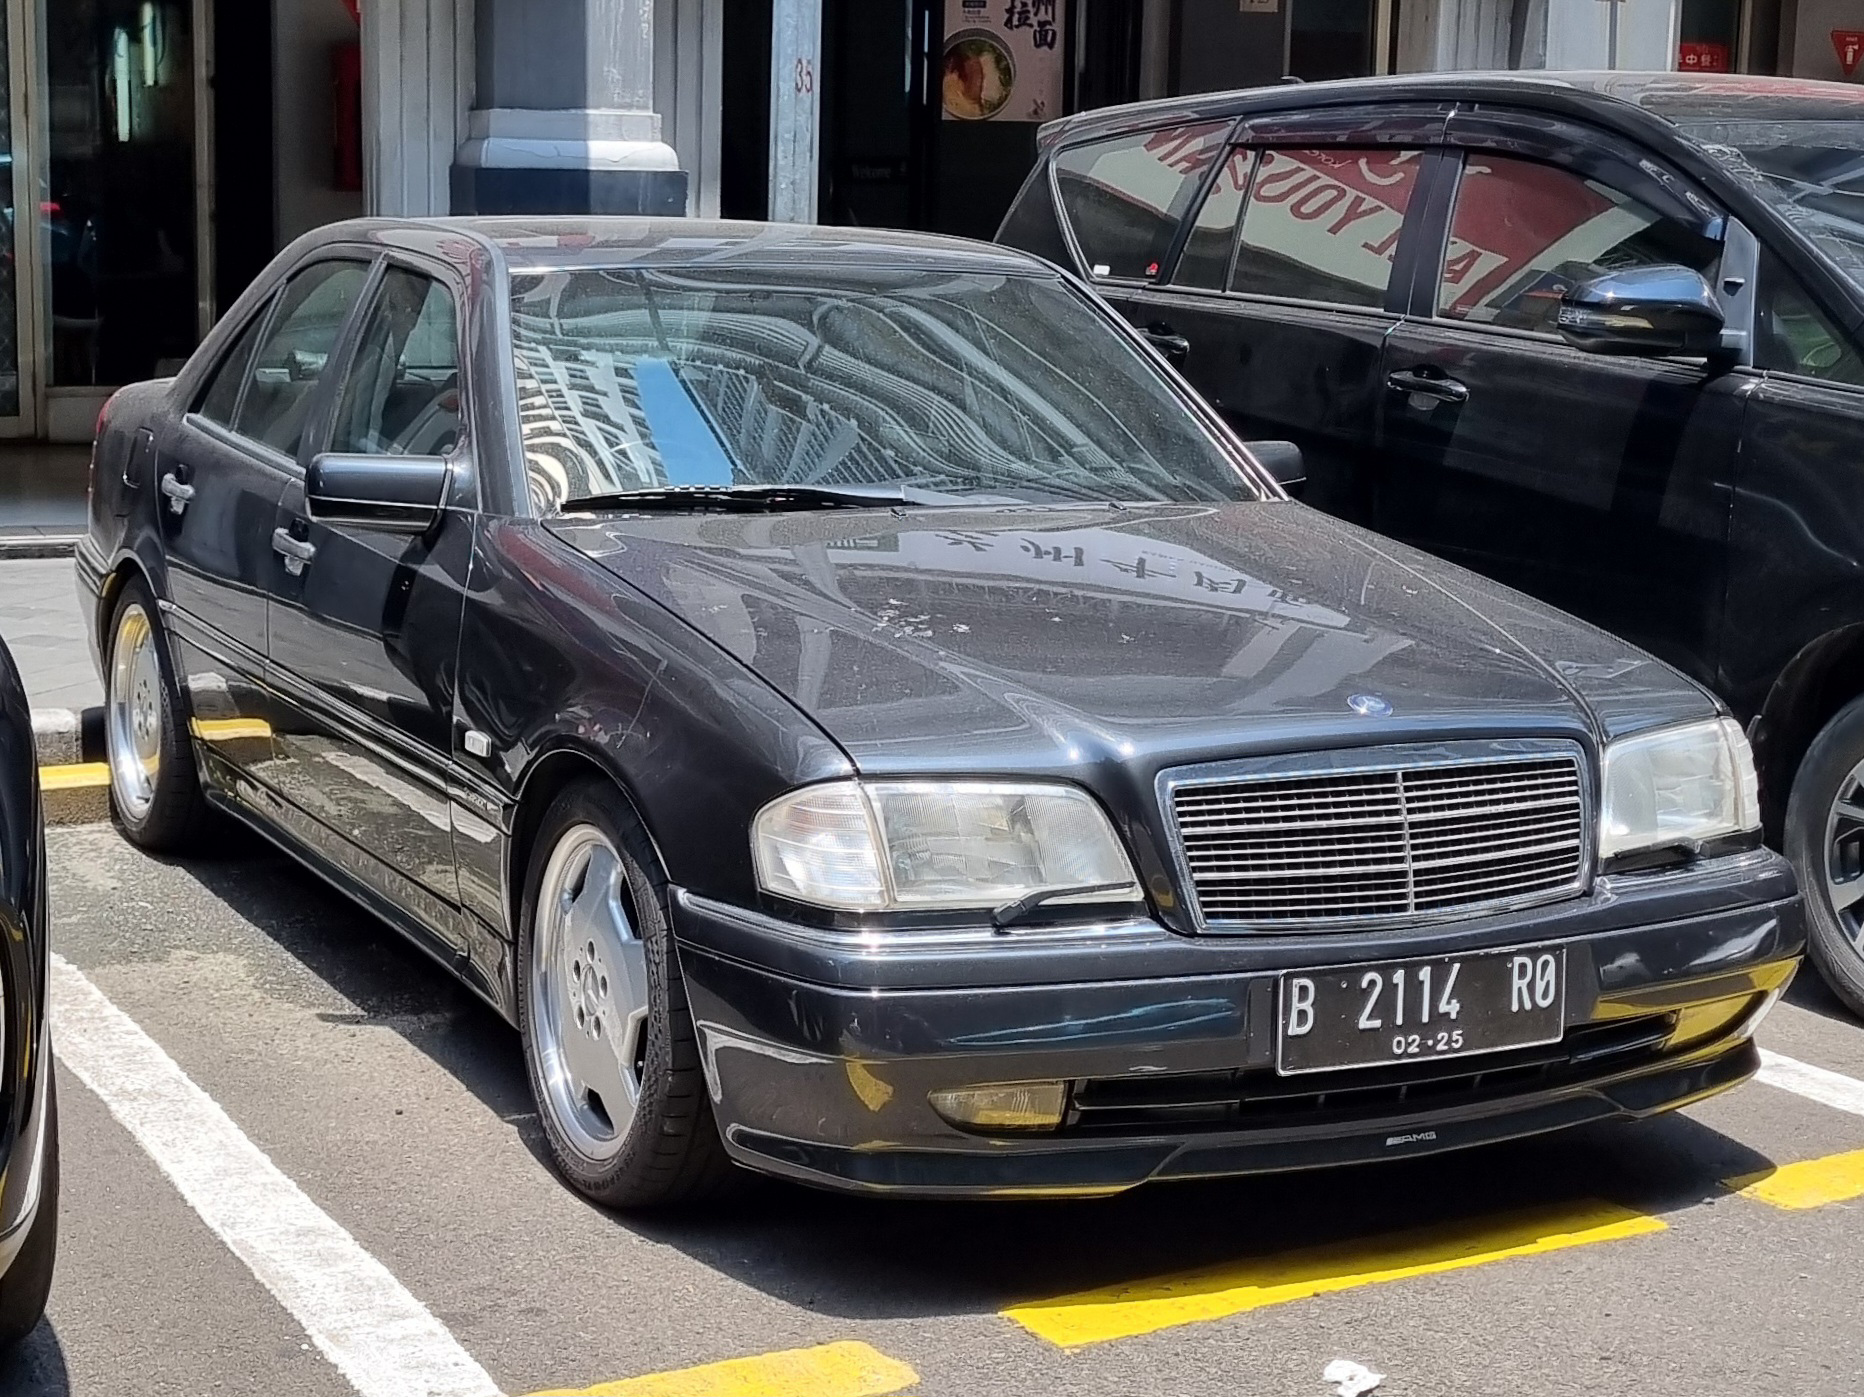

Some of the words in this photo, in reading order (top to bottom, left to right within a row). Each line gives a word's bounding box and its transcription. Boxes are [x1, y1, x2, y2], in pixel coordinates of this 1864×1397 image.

[794, 57, 814, 94] 35
[1288, 978, 1315, 1036] B
[1357, 962, 1461, 1030] 2114
[1397, 1131, 1437, 1144] AMG
